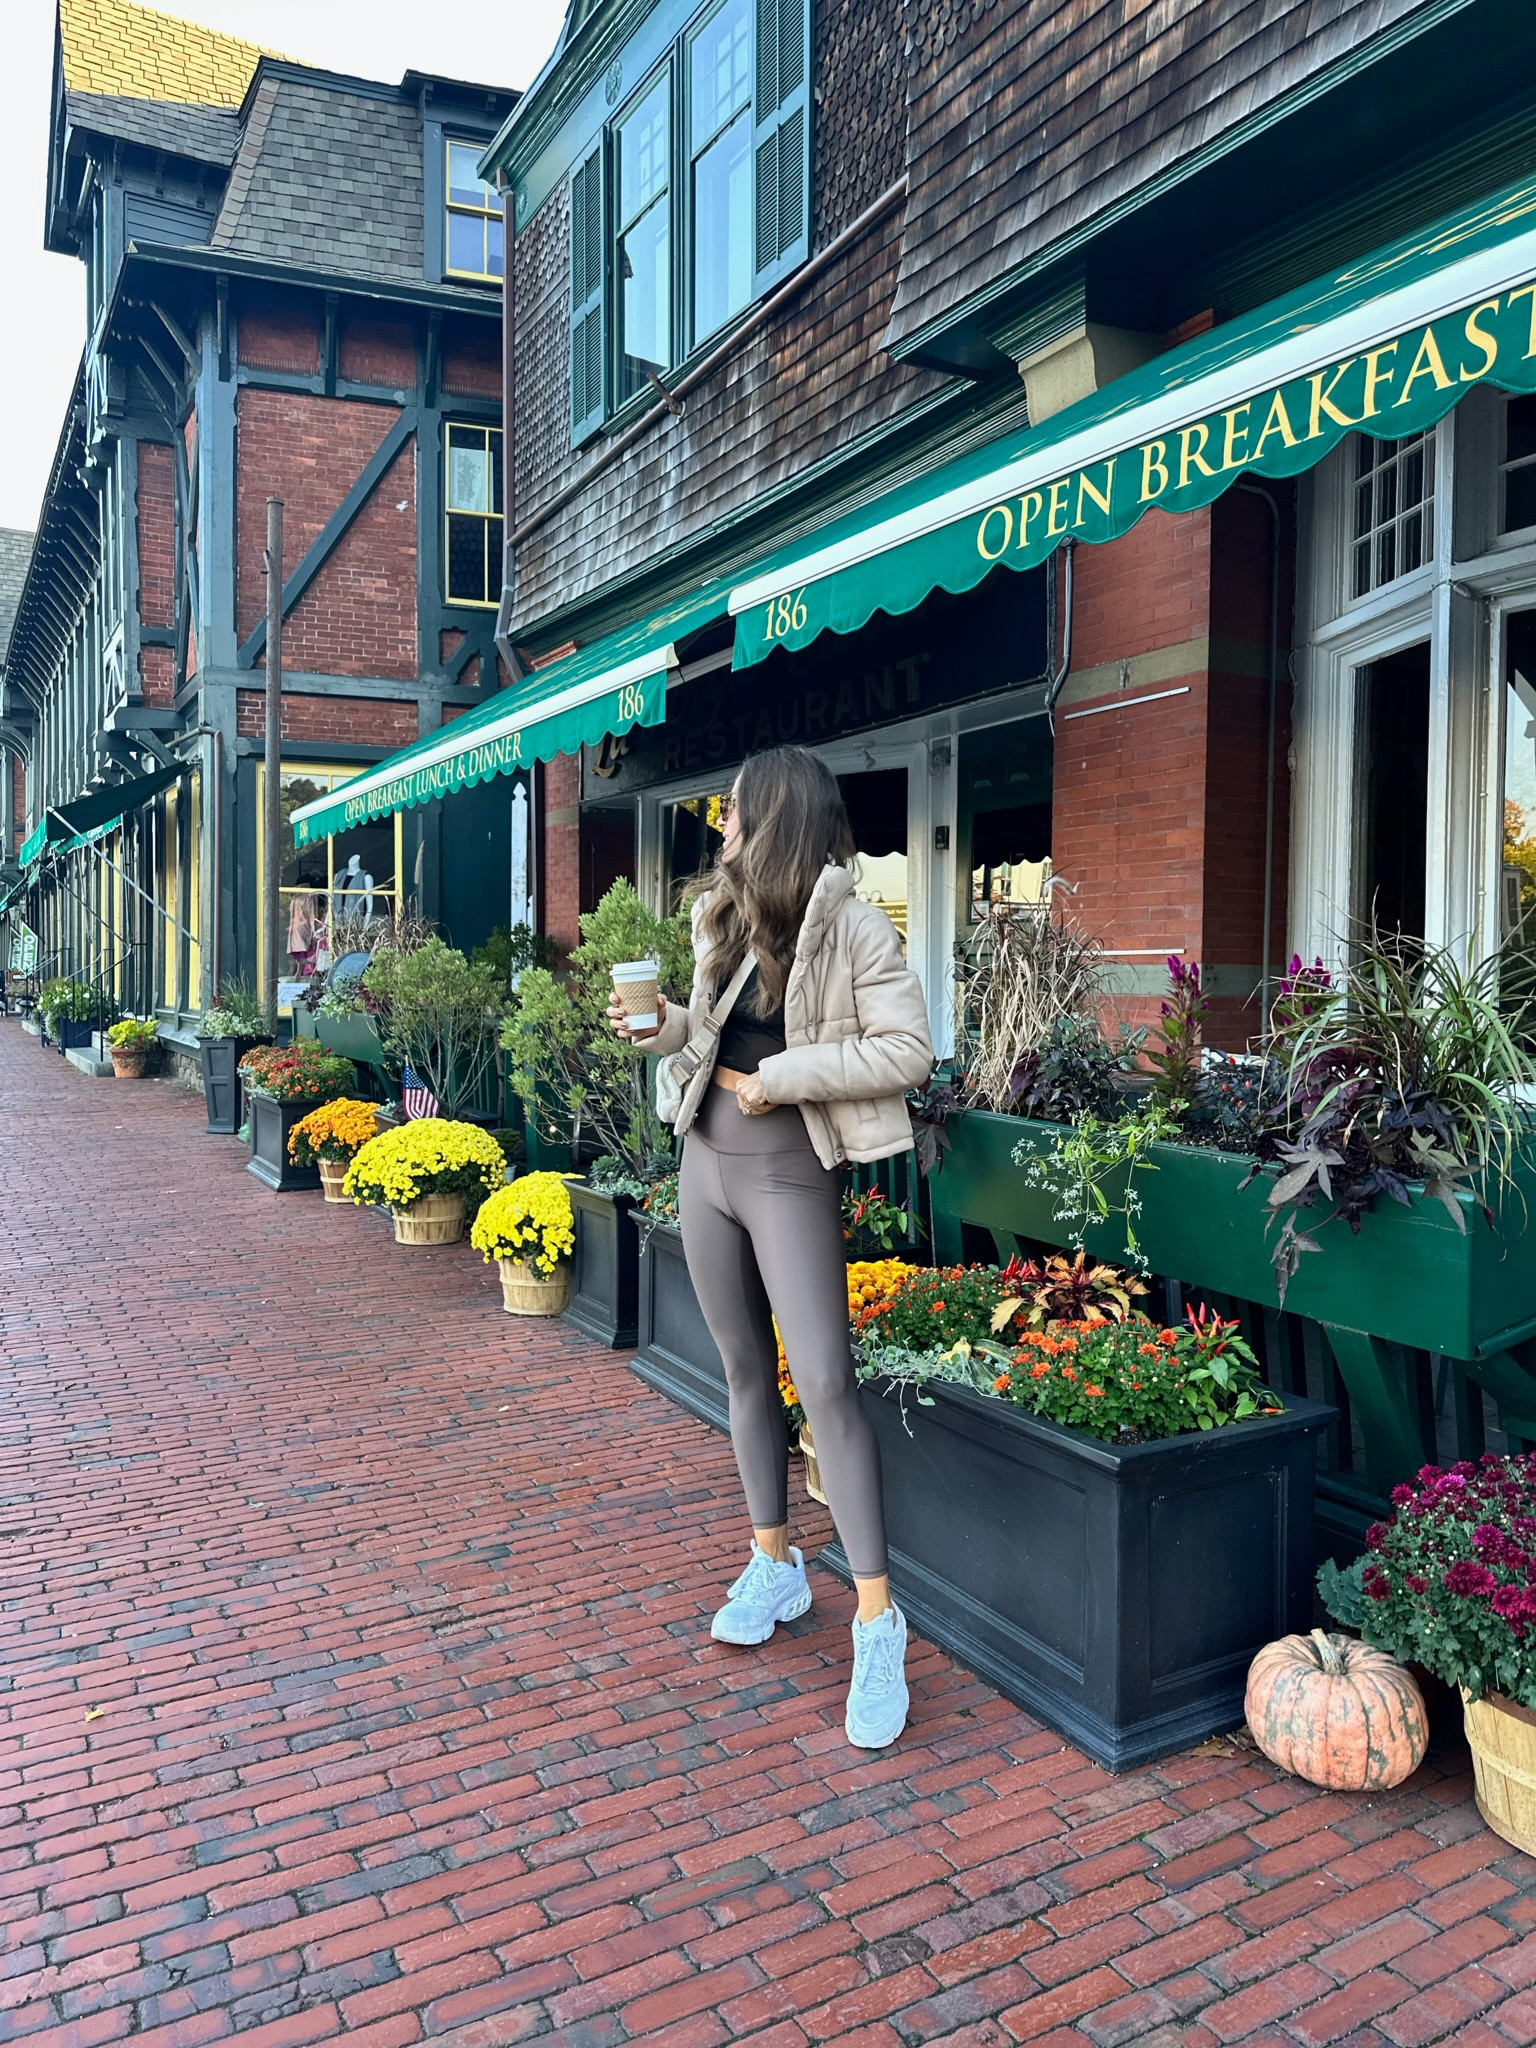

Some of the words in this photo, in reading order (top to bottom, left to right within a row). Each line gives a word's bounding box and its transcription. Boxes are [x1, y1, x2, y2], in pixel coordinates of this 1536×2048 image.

[977, 458, 1118, 560] OPEN
[762, 587, 808, 642] 186
[617, 681, 644, 722] 186
[665, 653, 931, 771] RESTAURANT
[344, 795, 365, 822] OPEN
[366, 777, 414, 814] BREAKFAST
[416, 763, 453, 796] LUNCH
[456, 754, 467, 780] &
[468, 732, 522, 776] DINNER
[23, 934, 36, 974] OPEN
